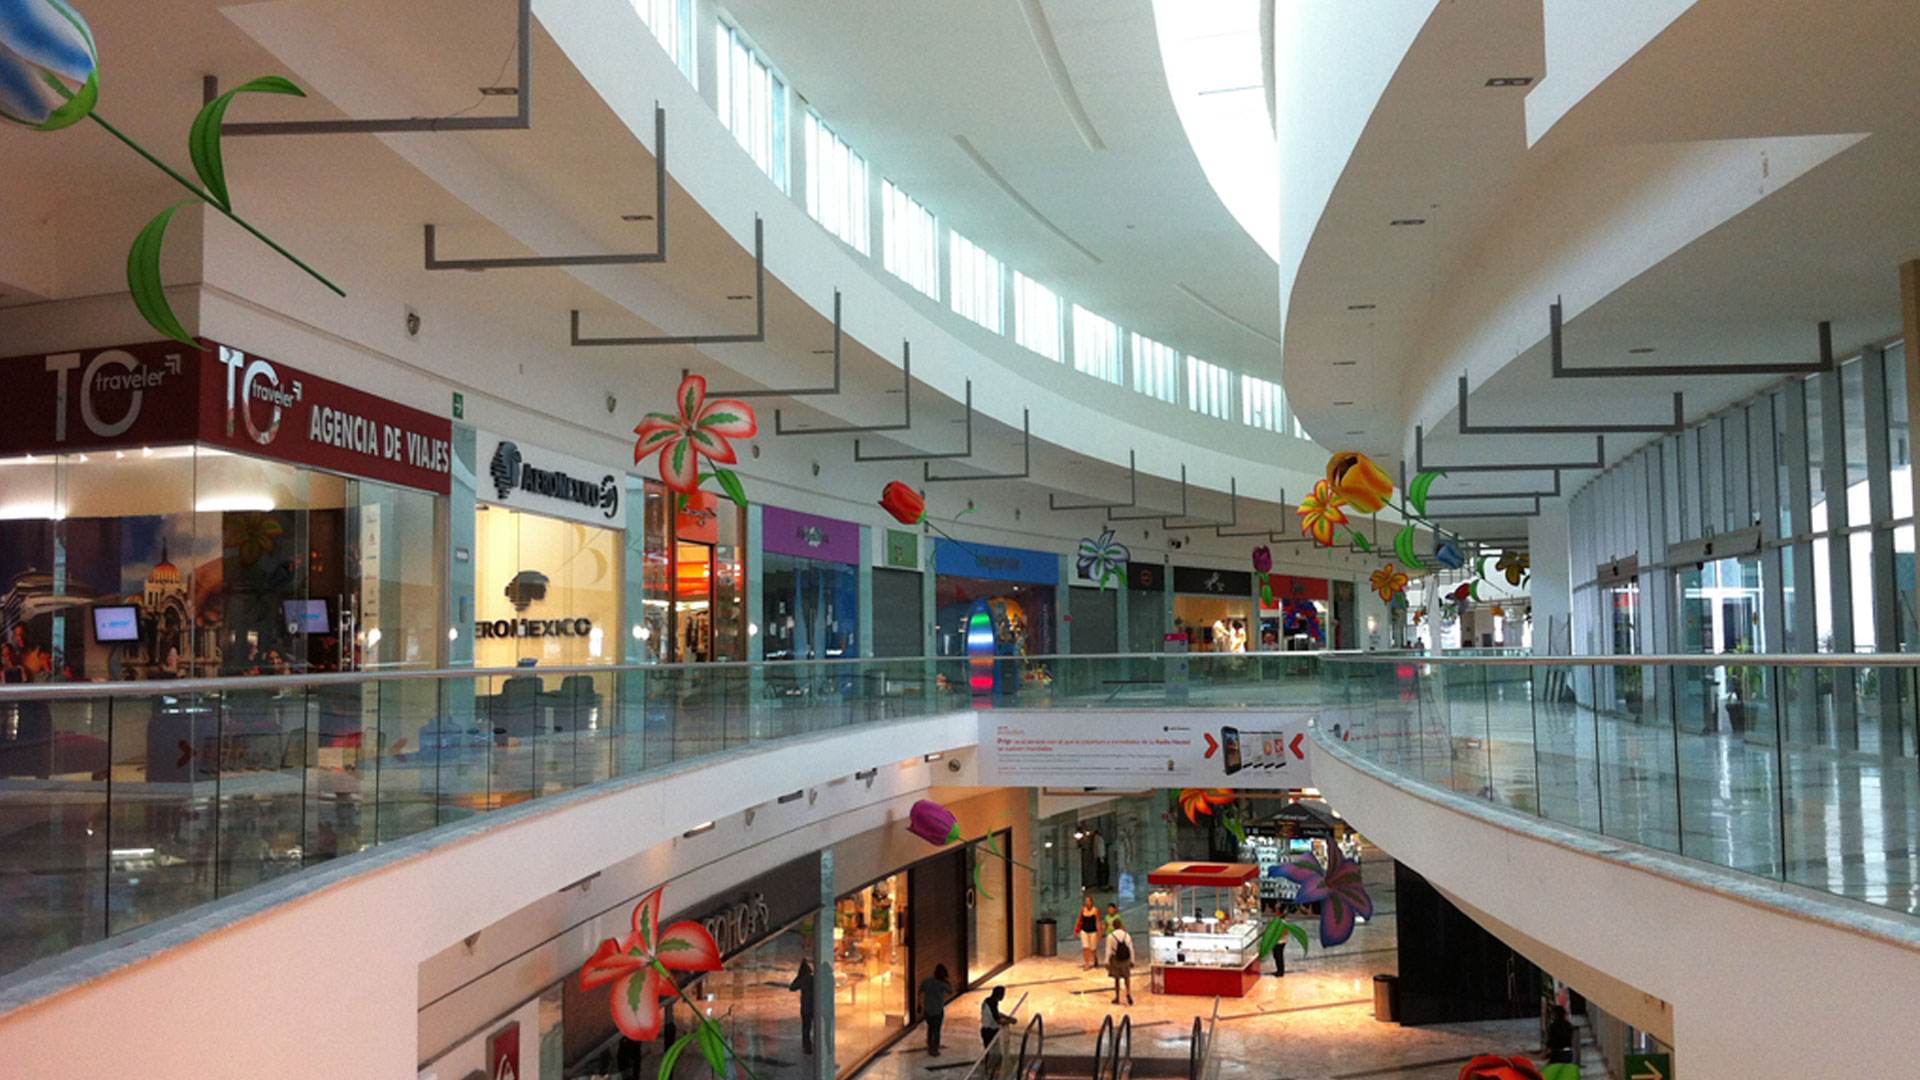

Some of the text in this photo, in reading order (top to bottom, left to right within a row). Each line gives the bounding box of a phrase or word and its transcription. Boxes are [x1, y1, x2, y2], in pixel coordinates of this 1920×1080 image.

[96, 364, 165, 391] traveler
[252, 379, 294, 408] traveler
[310, 405, 450, 474] AGENCIA DE VIAJES
